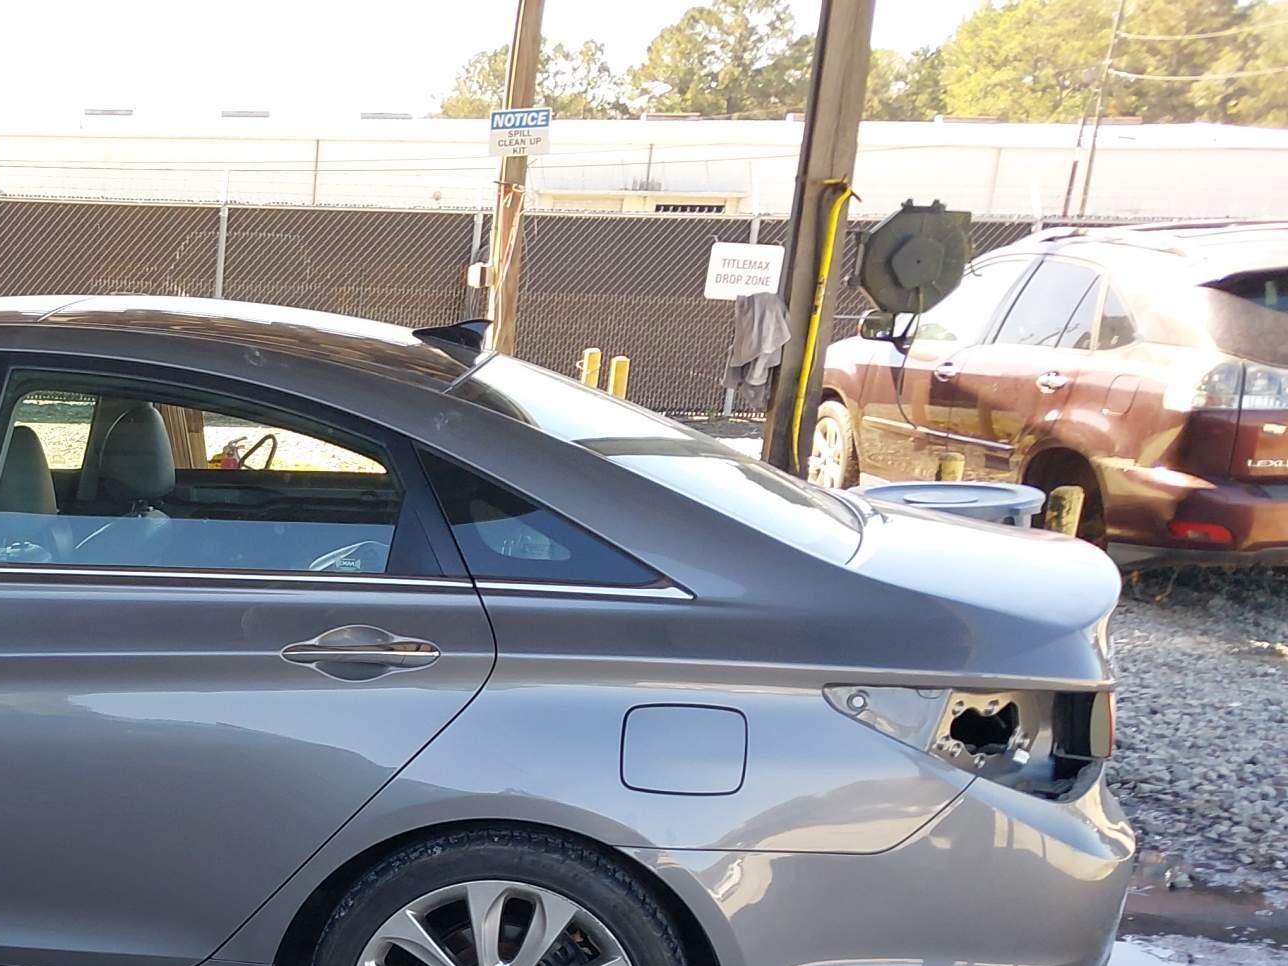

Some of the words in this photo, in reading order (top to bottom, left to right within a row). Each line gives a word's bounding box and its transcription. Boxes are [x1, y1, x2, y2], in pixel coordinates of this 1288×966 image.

[493, 112, 549, 128] NOTICE
[508, 129, 532, 138] SPILL
[498, 139, 526, 147] CLEAN
[529, 137, 542, 145] UP
[722, 258, 770, 271] TITLEMAX
[715, 273, 743, 285] DROP
[744, 275, 771, 287] ZONE
